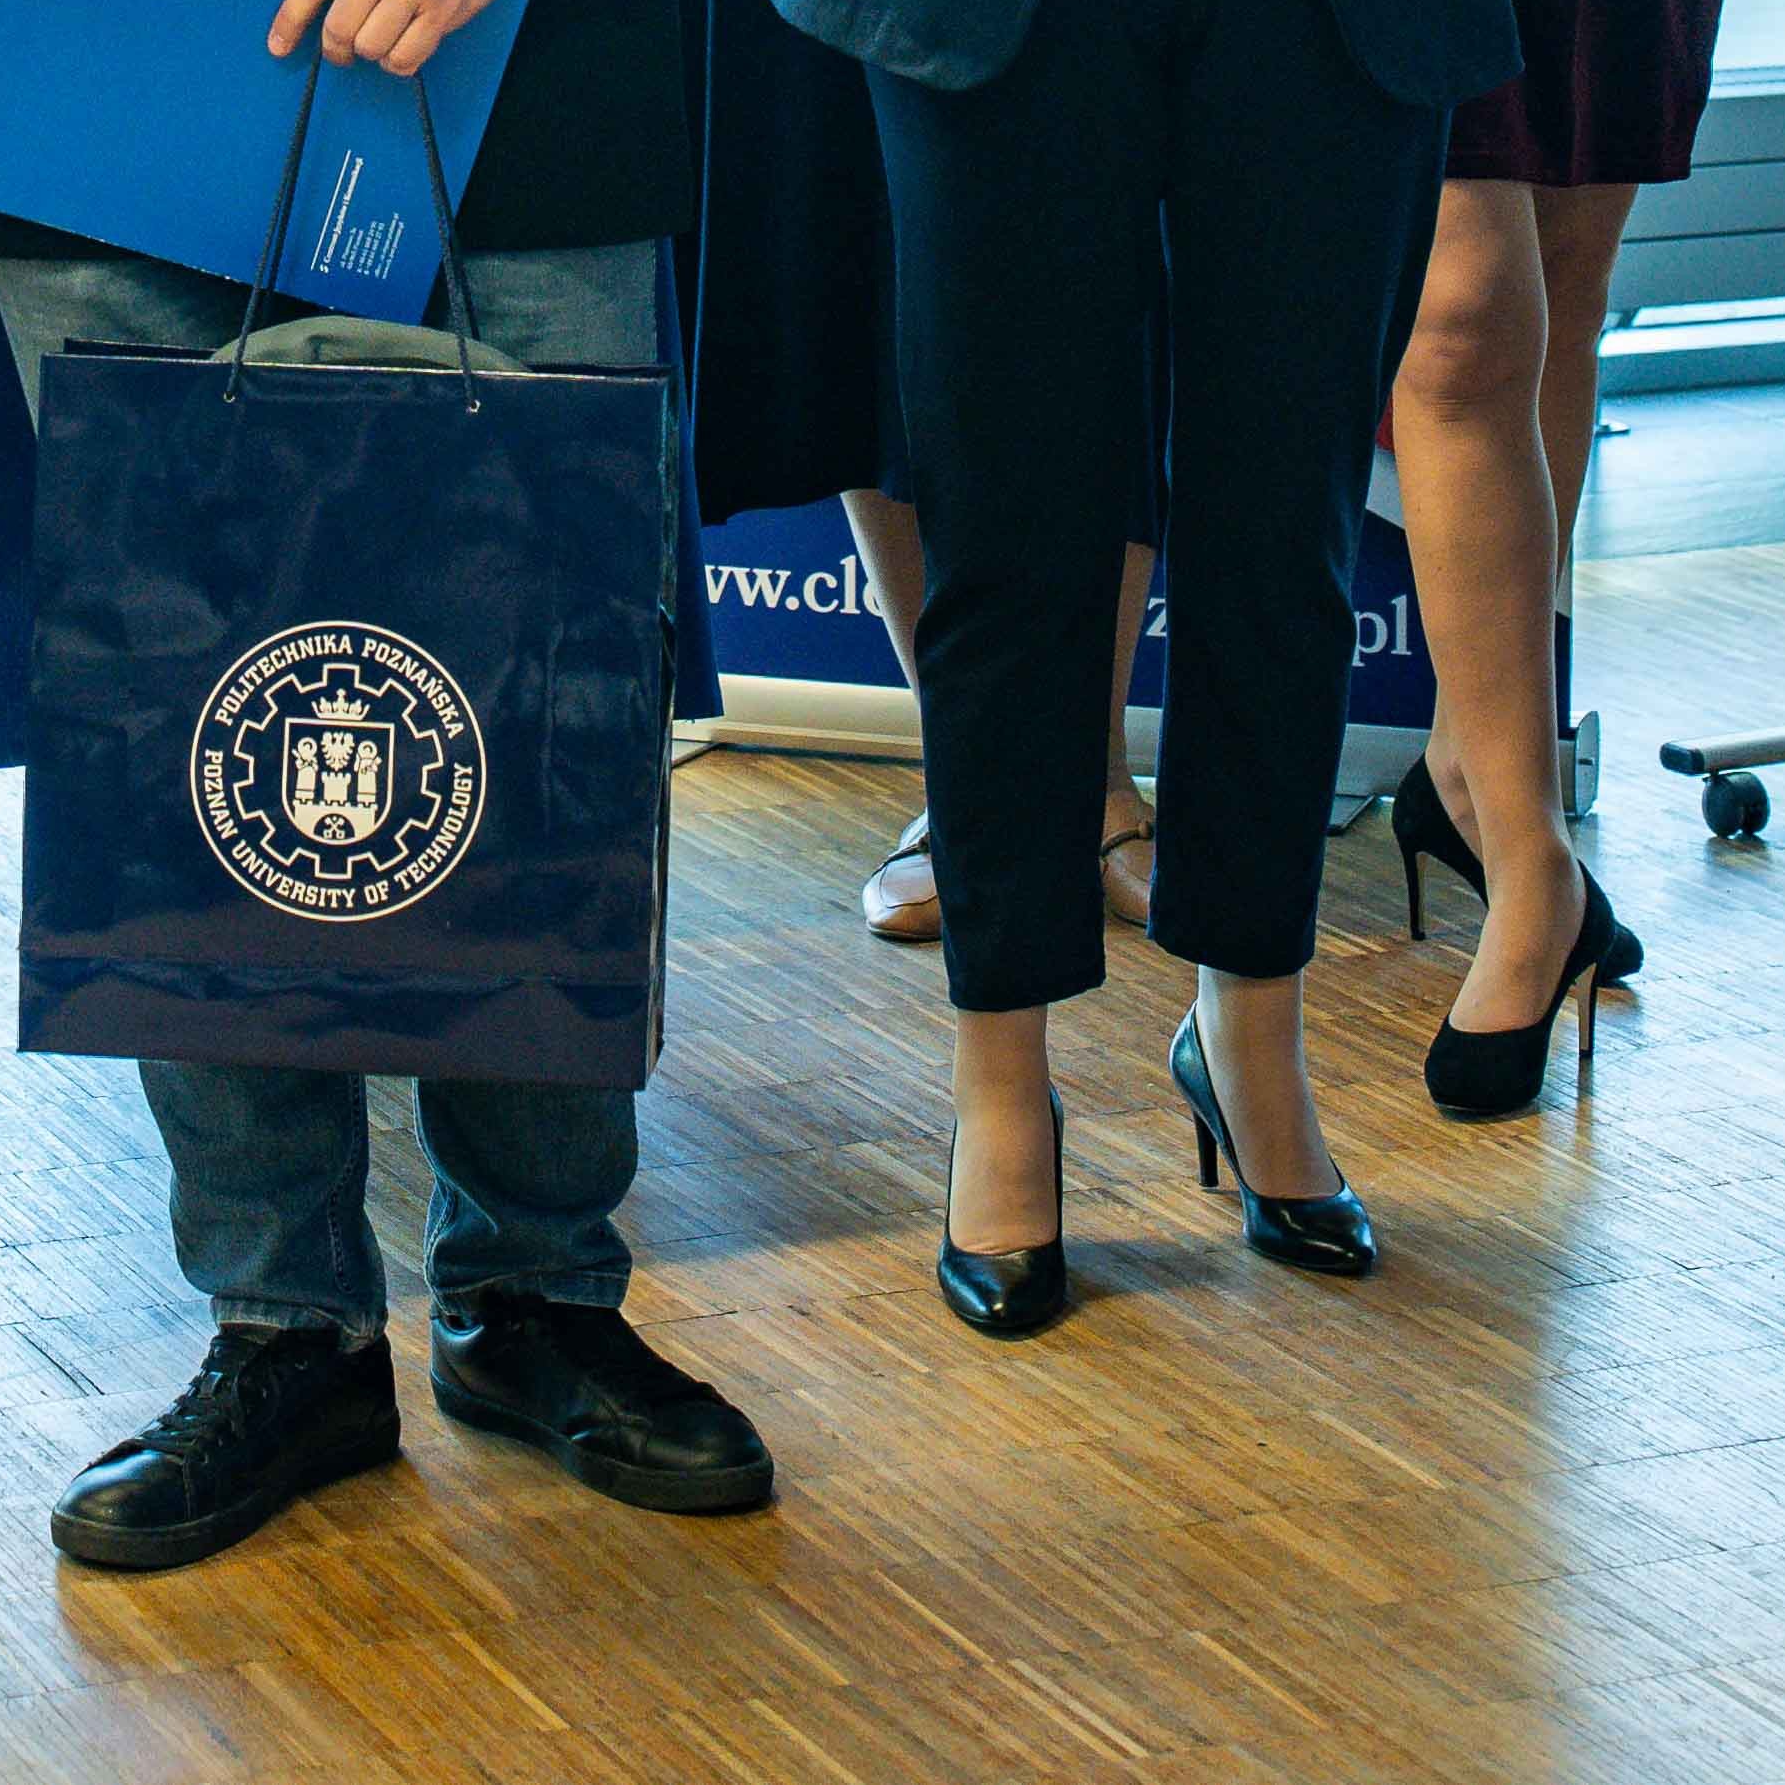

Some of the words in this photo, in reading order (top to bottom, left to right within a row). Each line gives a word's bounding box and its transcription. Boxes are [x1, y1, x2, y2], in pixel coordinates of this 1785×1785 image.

[214, 633, 353, 727] POLITECHNIKA
[361, 637, 465, 739] POZNAŃSKA
[203, 748, 238, 840] POZNAN
[231, 839, 356, 909] UNIVERSITY
[363, 882, 391, 905] OF
[394, 761, 473, 892] TECHNOLOGY
